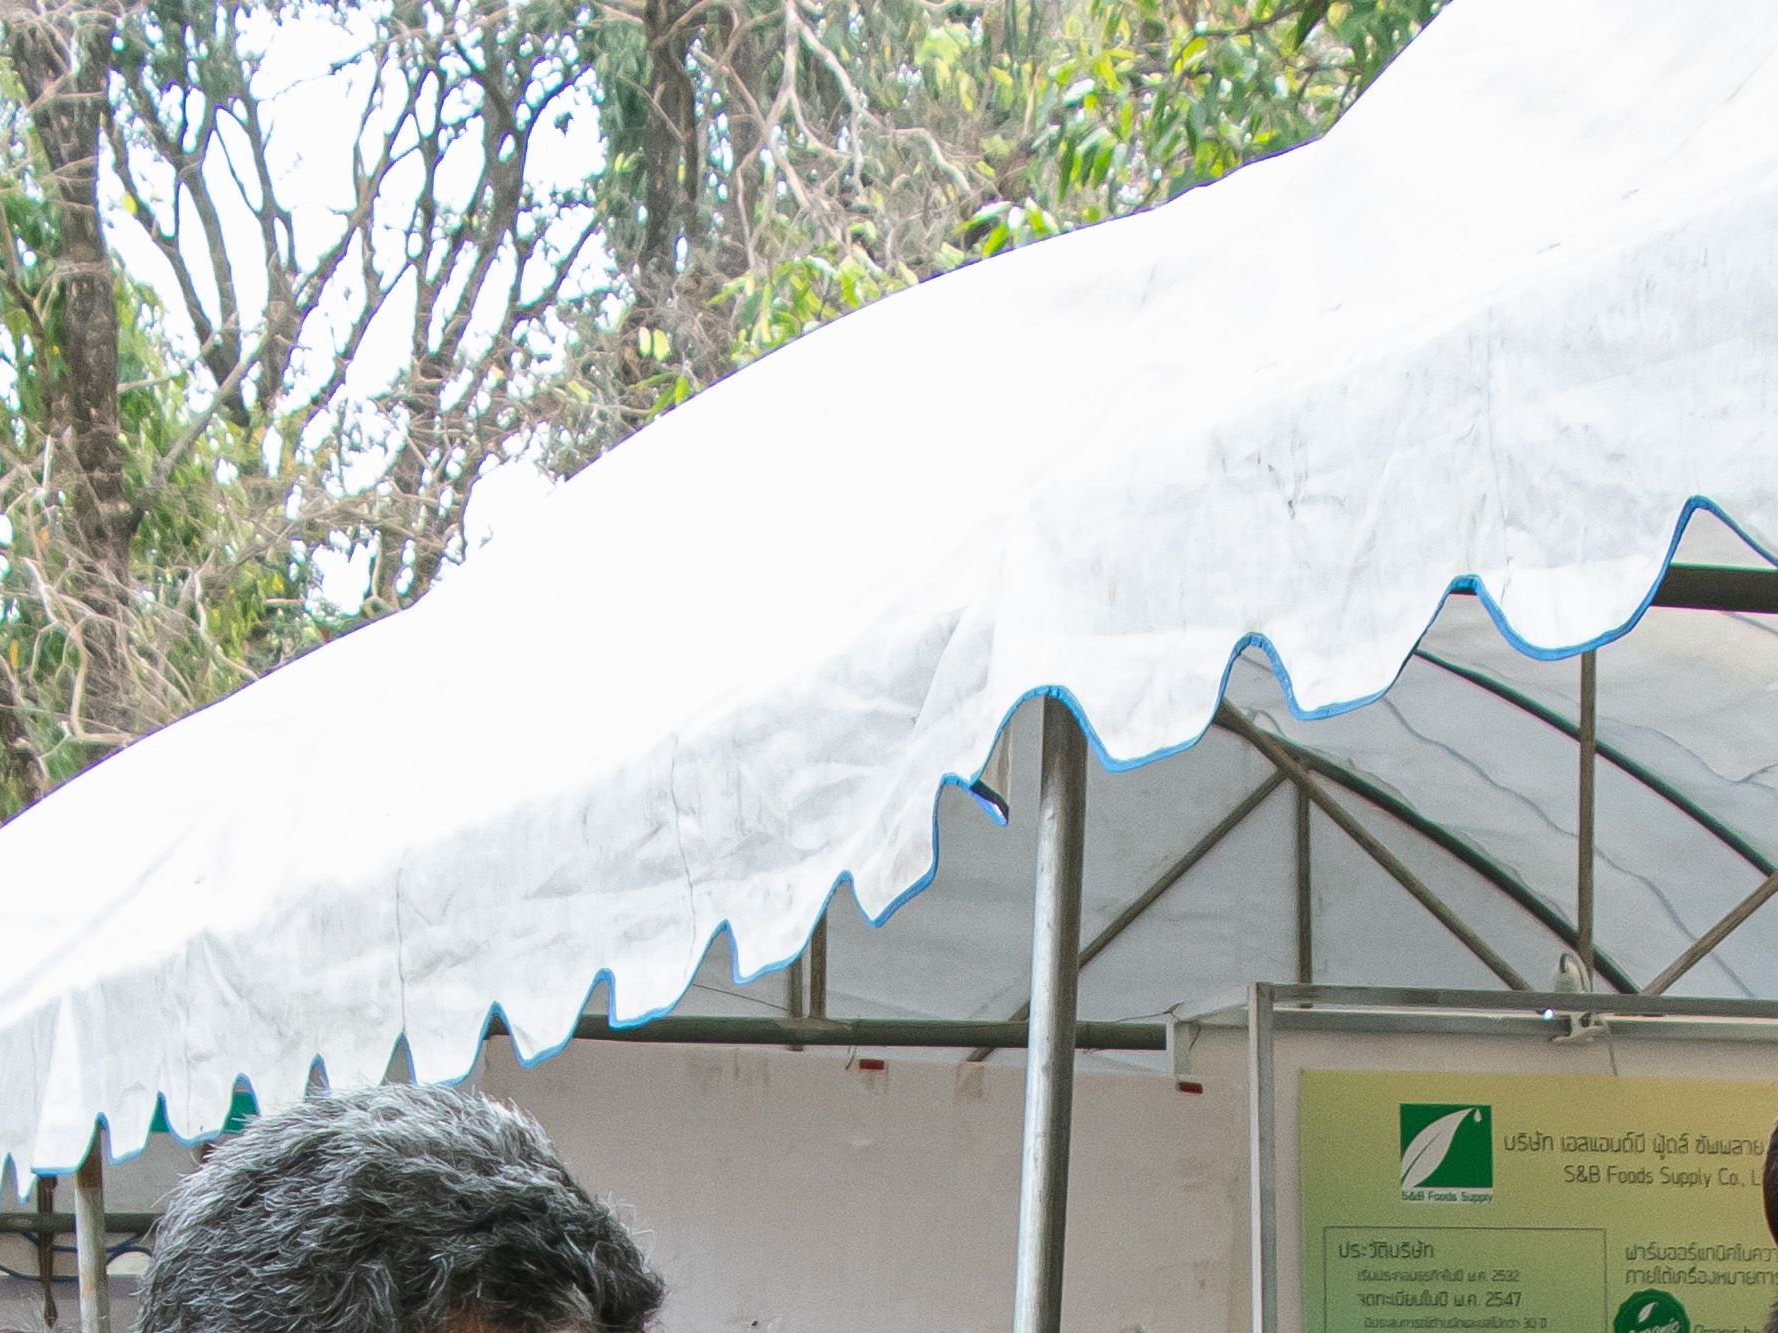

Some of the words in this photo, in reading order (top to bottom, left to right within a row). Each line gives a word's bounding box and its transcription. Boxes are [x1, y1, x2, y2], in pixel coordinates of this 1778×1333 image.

[1564, 1166, 1600, 1183] S&B
[1607, 1166, 1653, 1184] Foods
[1660, 1168, 1710, 1187] Supply
[1338, 1241, 1434, 1259] ประวัติบริษัท
[1485, 1291, 1521, 1307] 2547
